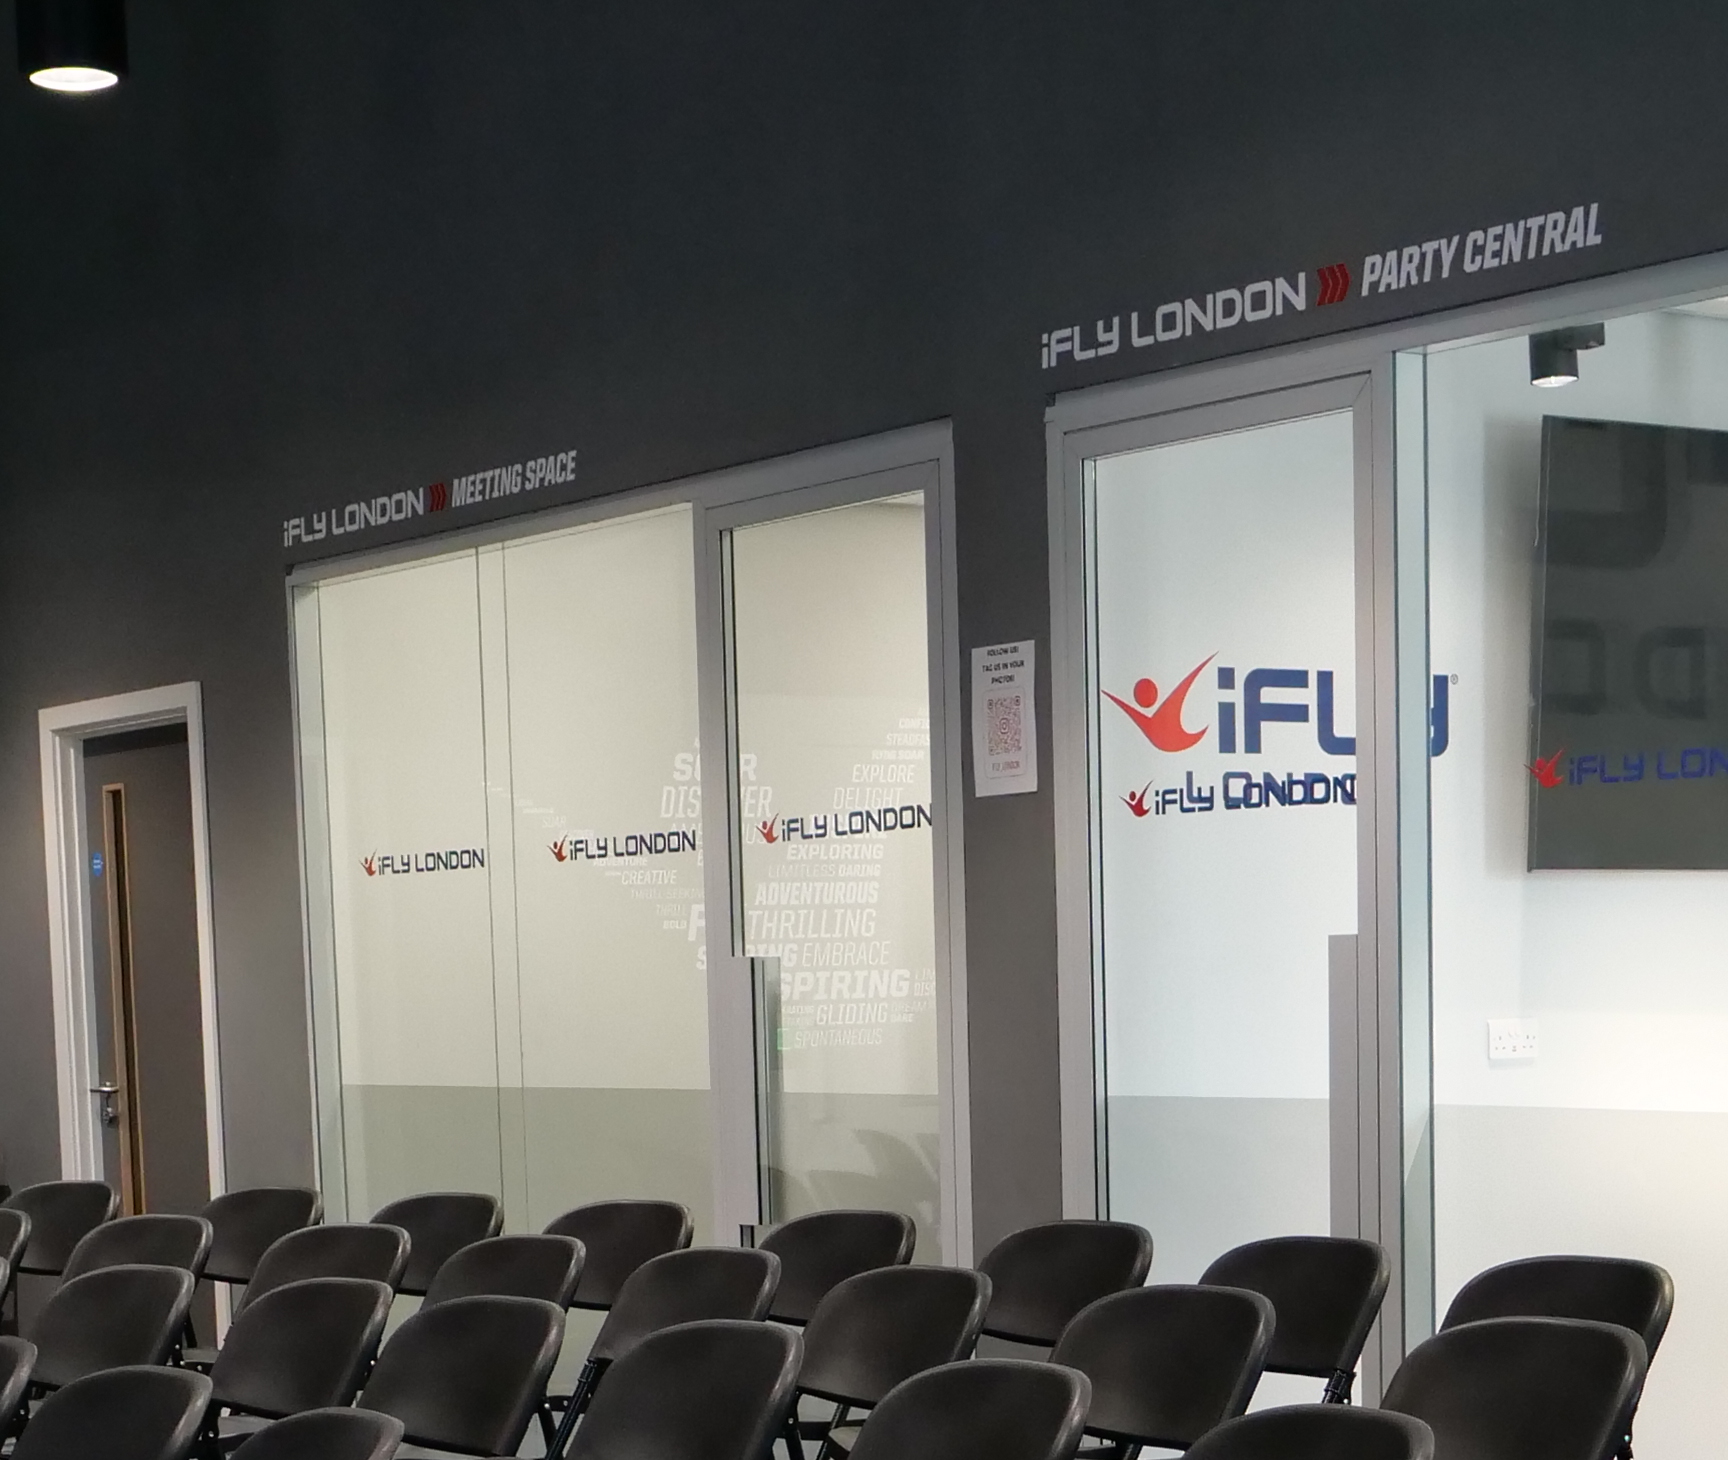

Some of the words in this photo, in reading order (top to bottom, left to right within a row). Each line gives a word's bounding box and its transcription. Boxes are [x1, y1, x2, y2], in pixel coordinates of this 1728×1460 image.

[1130, 272, 1306, 347] LONDON
[1361, 235, 1459, 296] PARTY
[1463, 203, 1602, 273] CENTRAL
[331, 487, 425, 535] LONDON
[452, 463, 522, 507] MEETING
[525, 450, 578, 491] SPACE
[852, 764, 915, 783] EXPLORE
[833, 787, 904, 810] DELIGHT
[1224, 775, 1356, 809] LONDON
[834, 803, 932, 836] LONDON
[613, 829, 696, 858] LONDON
[786, 843, 884, 861] EXPLORING
[415, 848, 485, 872] LONDON
[768, 864, 836, 878] LIMITLESS
[838, 864, 881, 878] DARING
[621, 870, 677, 885] CREATIVE
[754, 881, 879, 905] ADVENTUROUS
[748, 908, 877, 939] THRILLING
[802, 940, 891, 966] EMBRACE
[816, 1002, 889, 1025] GLIDING
[794, 1028, 883, 1049] SPONTANEOUS
